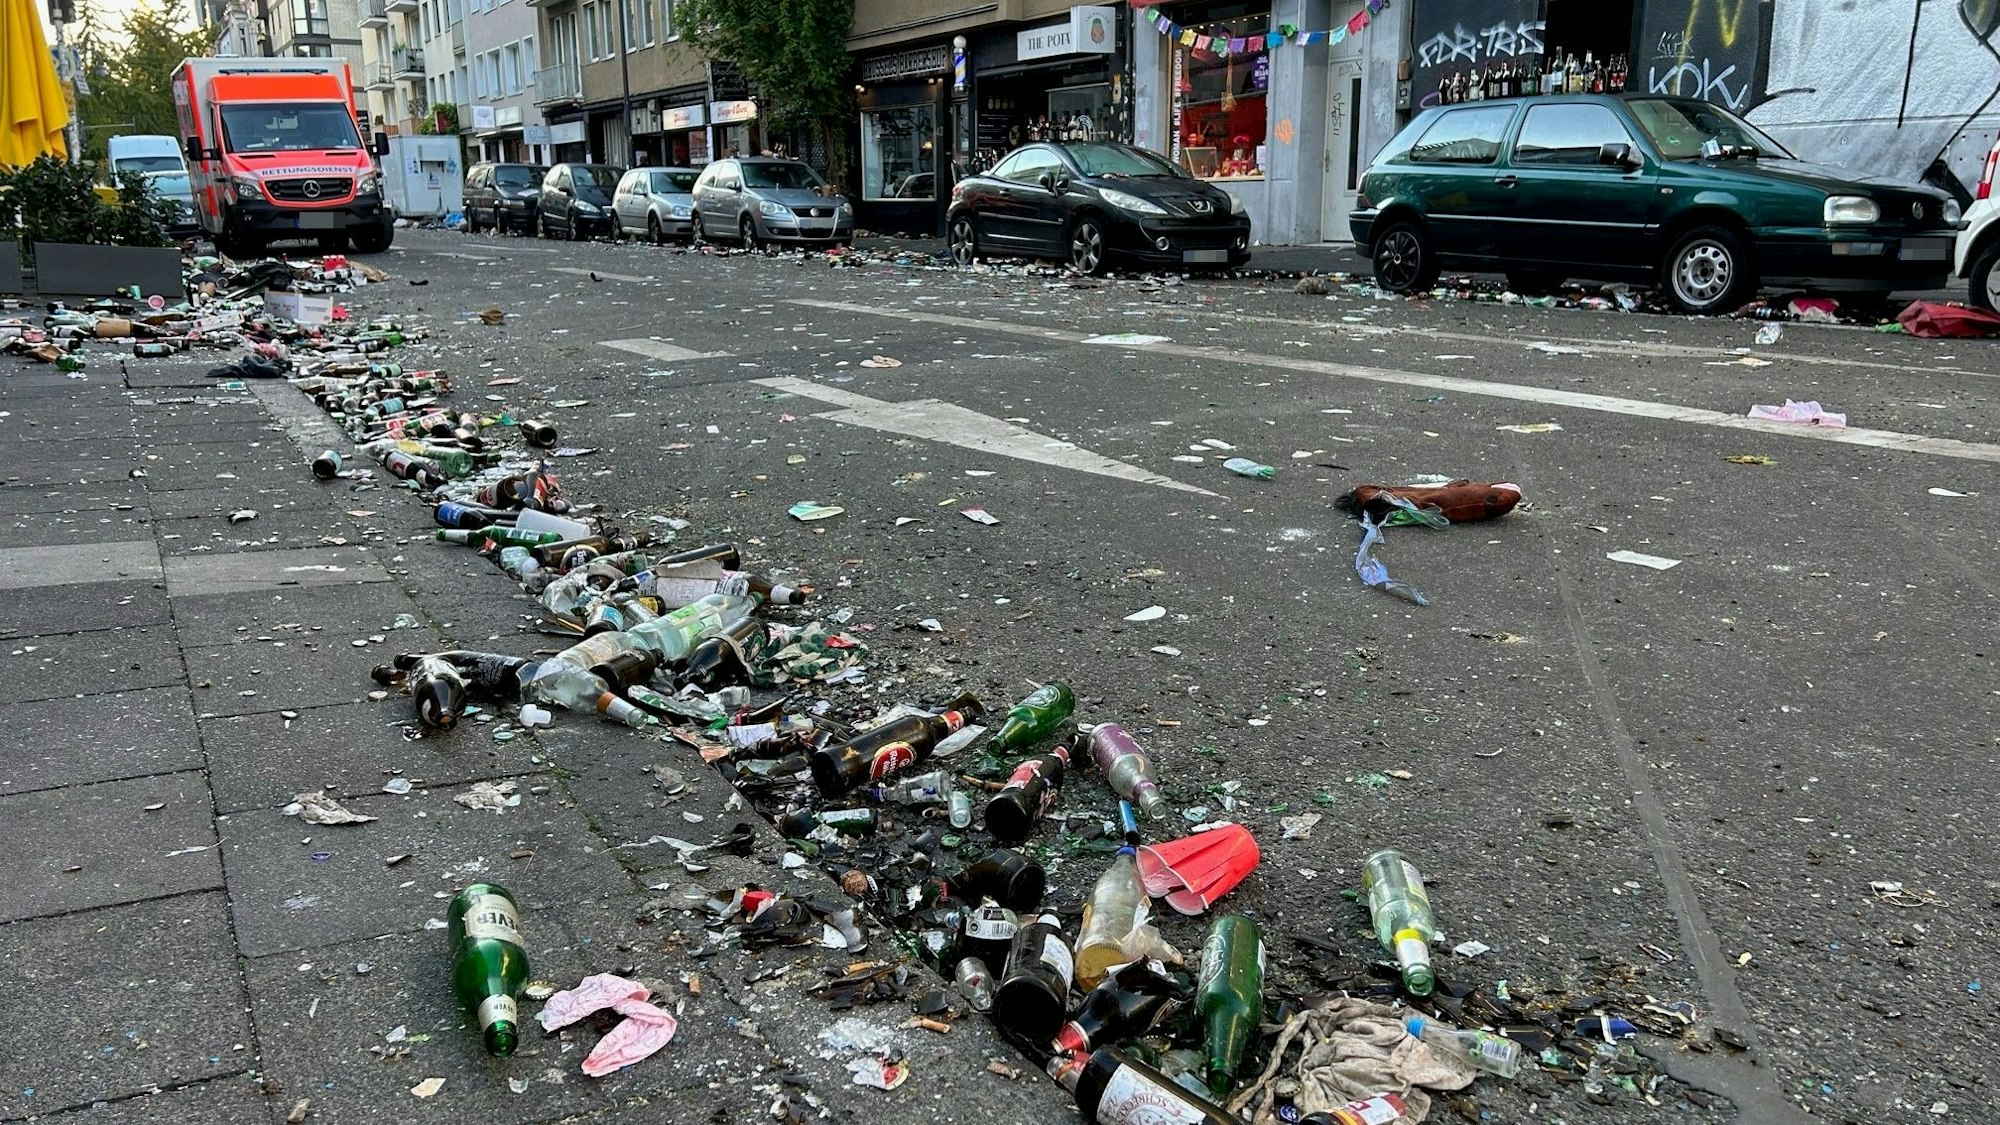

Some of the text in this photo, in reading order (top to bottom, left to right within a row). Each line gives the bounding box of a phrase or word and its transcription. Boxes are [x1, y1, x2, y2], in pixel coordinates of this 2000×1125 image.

[1028, 36, 1044, 51] THE
[1174, 49, 1183, 98] #FREEDOM
[1173, 101, 1181, 126] #LIFE
[261, 166, 354, 176] RETTUNGSDIENST
